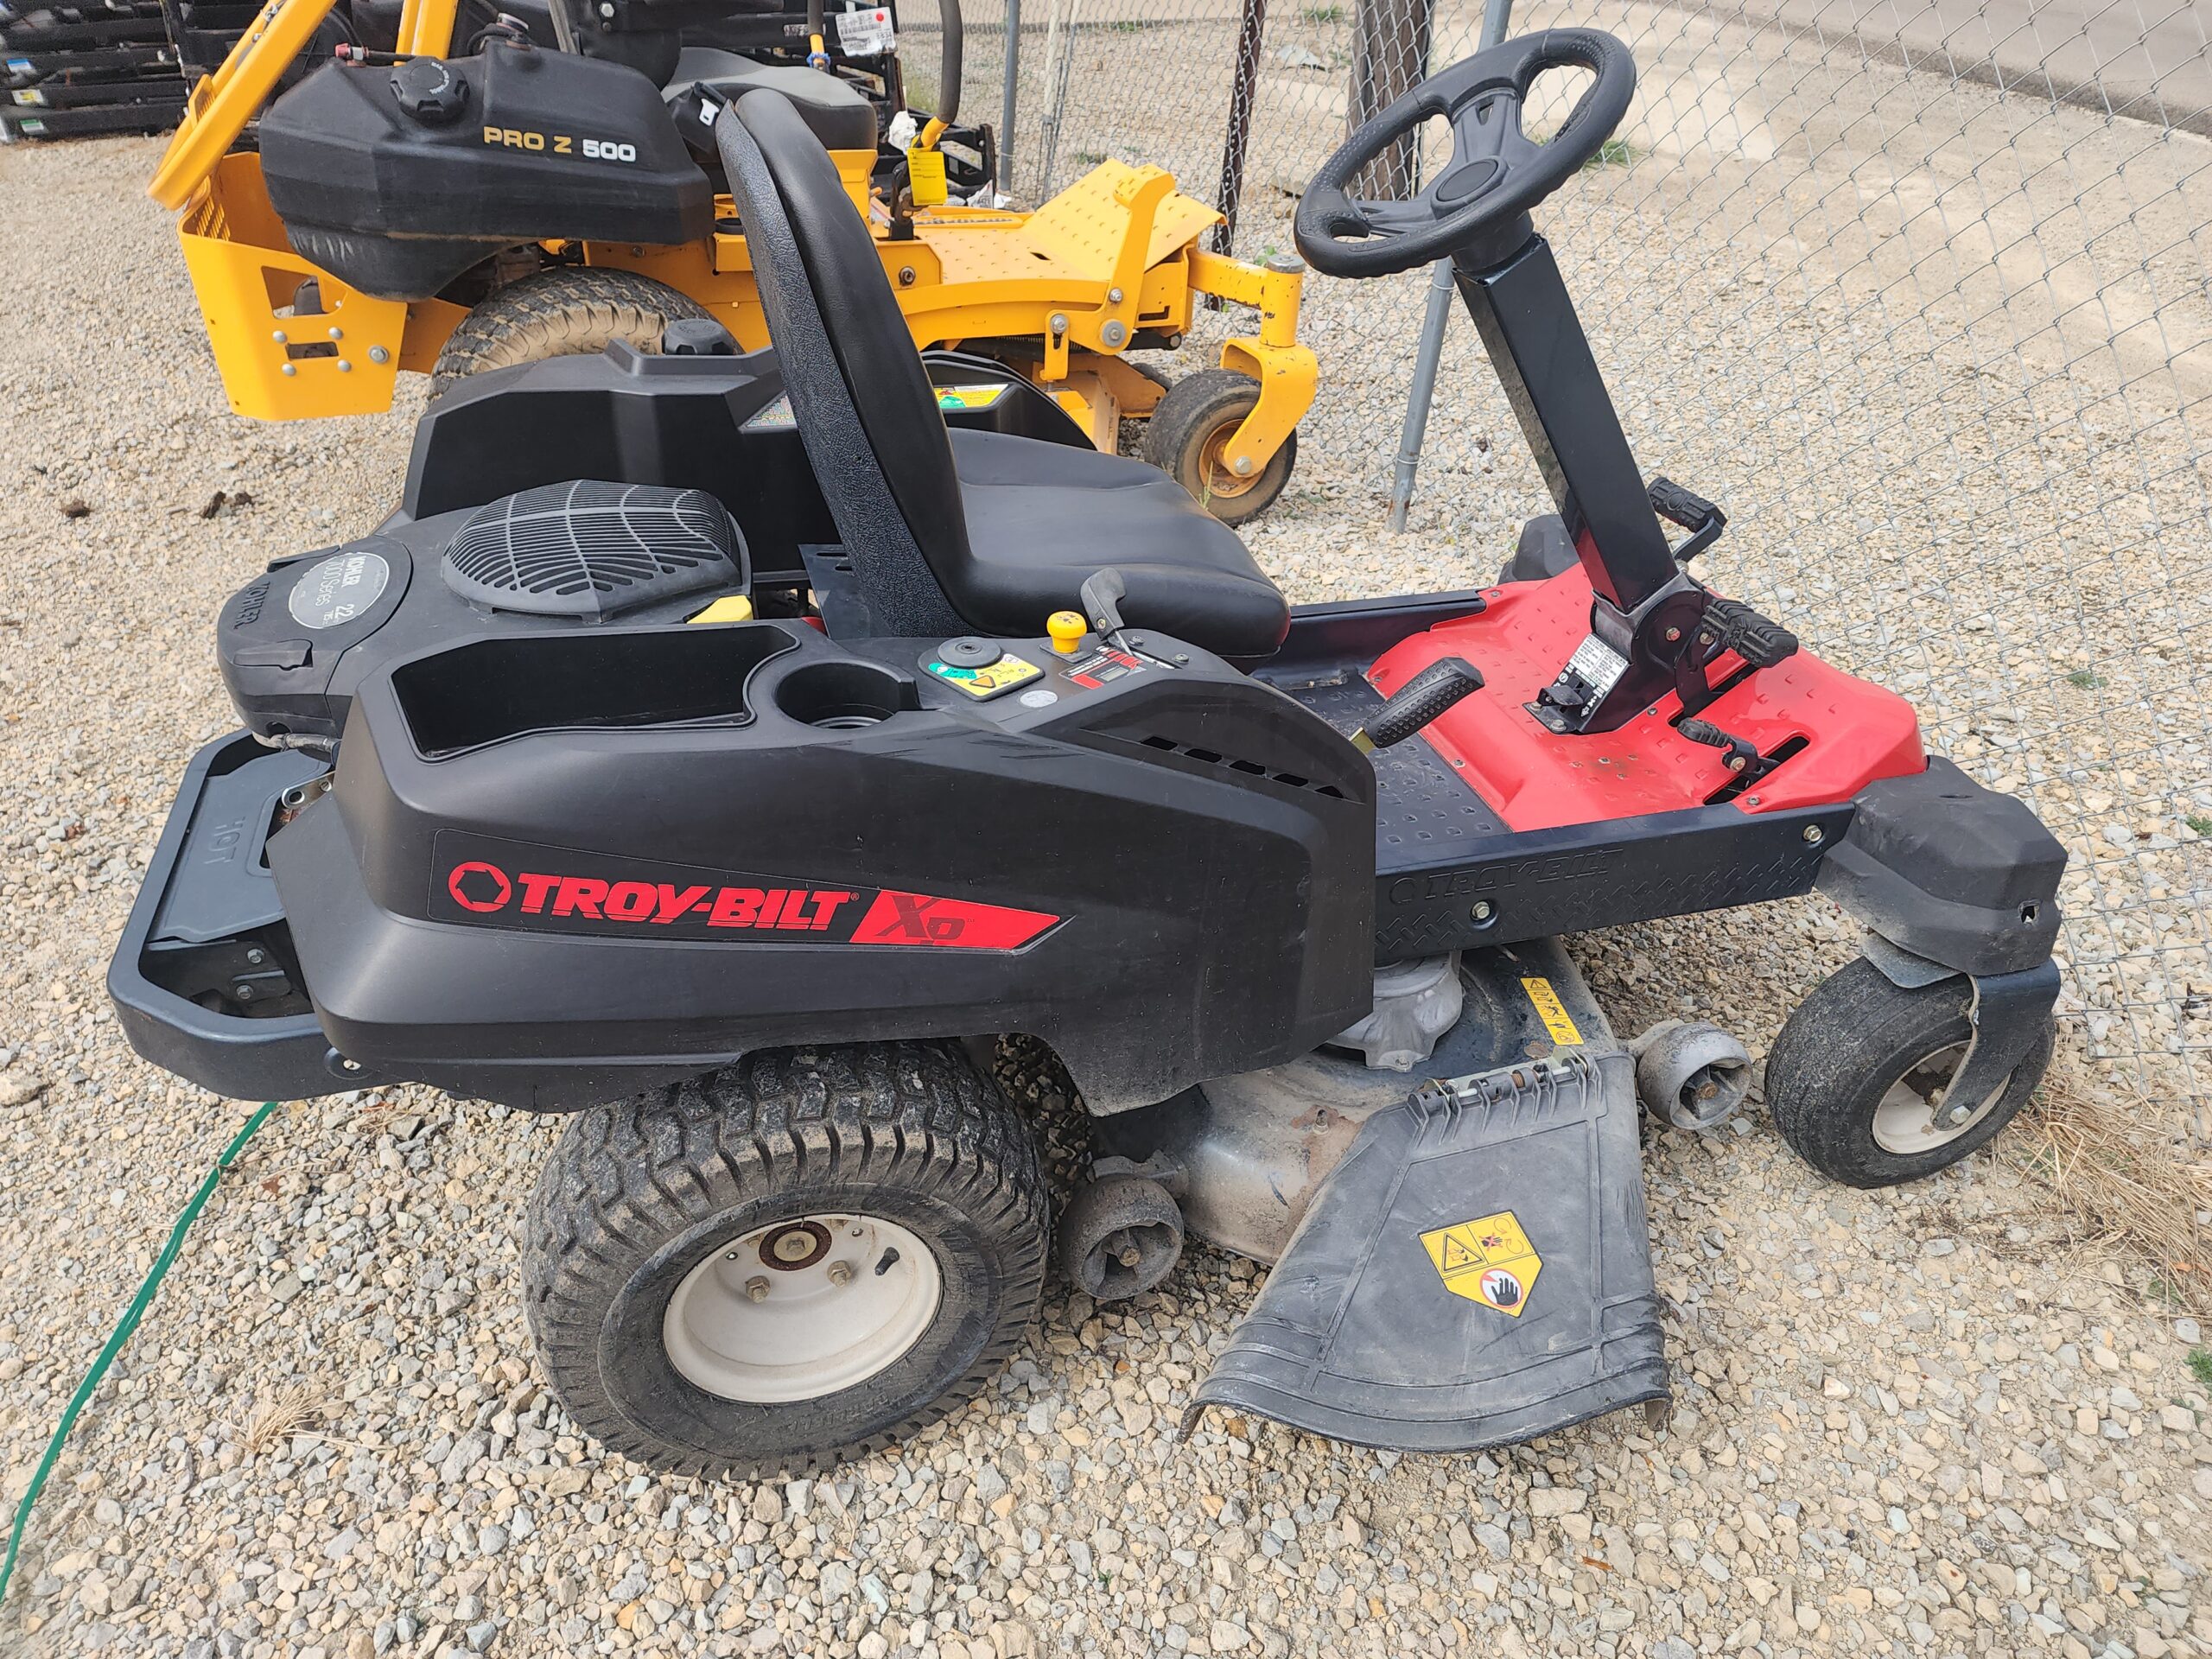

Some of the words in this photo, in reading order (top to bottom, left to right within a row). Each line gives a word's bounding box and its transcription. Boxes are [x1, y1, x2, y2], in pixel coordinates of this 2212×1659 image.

[483, 125, 545, 151] PRO
[553, 136, 572, 154] Z
[582, 138, 636, 162] 500
[322, 558, 346, 581] 7000
[340, 555, 367, 588] KOHLER
[315, 578, 340, 607] Series
[335, 603, 355, 619] 22
[204, 816, 246, 864] HOT
[1424, 849, 1624, 899] TROY-BILT
